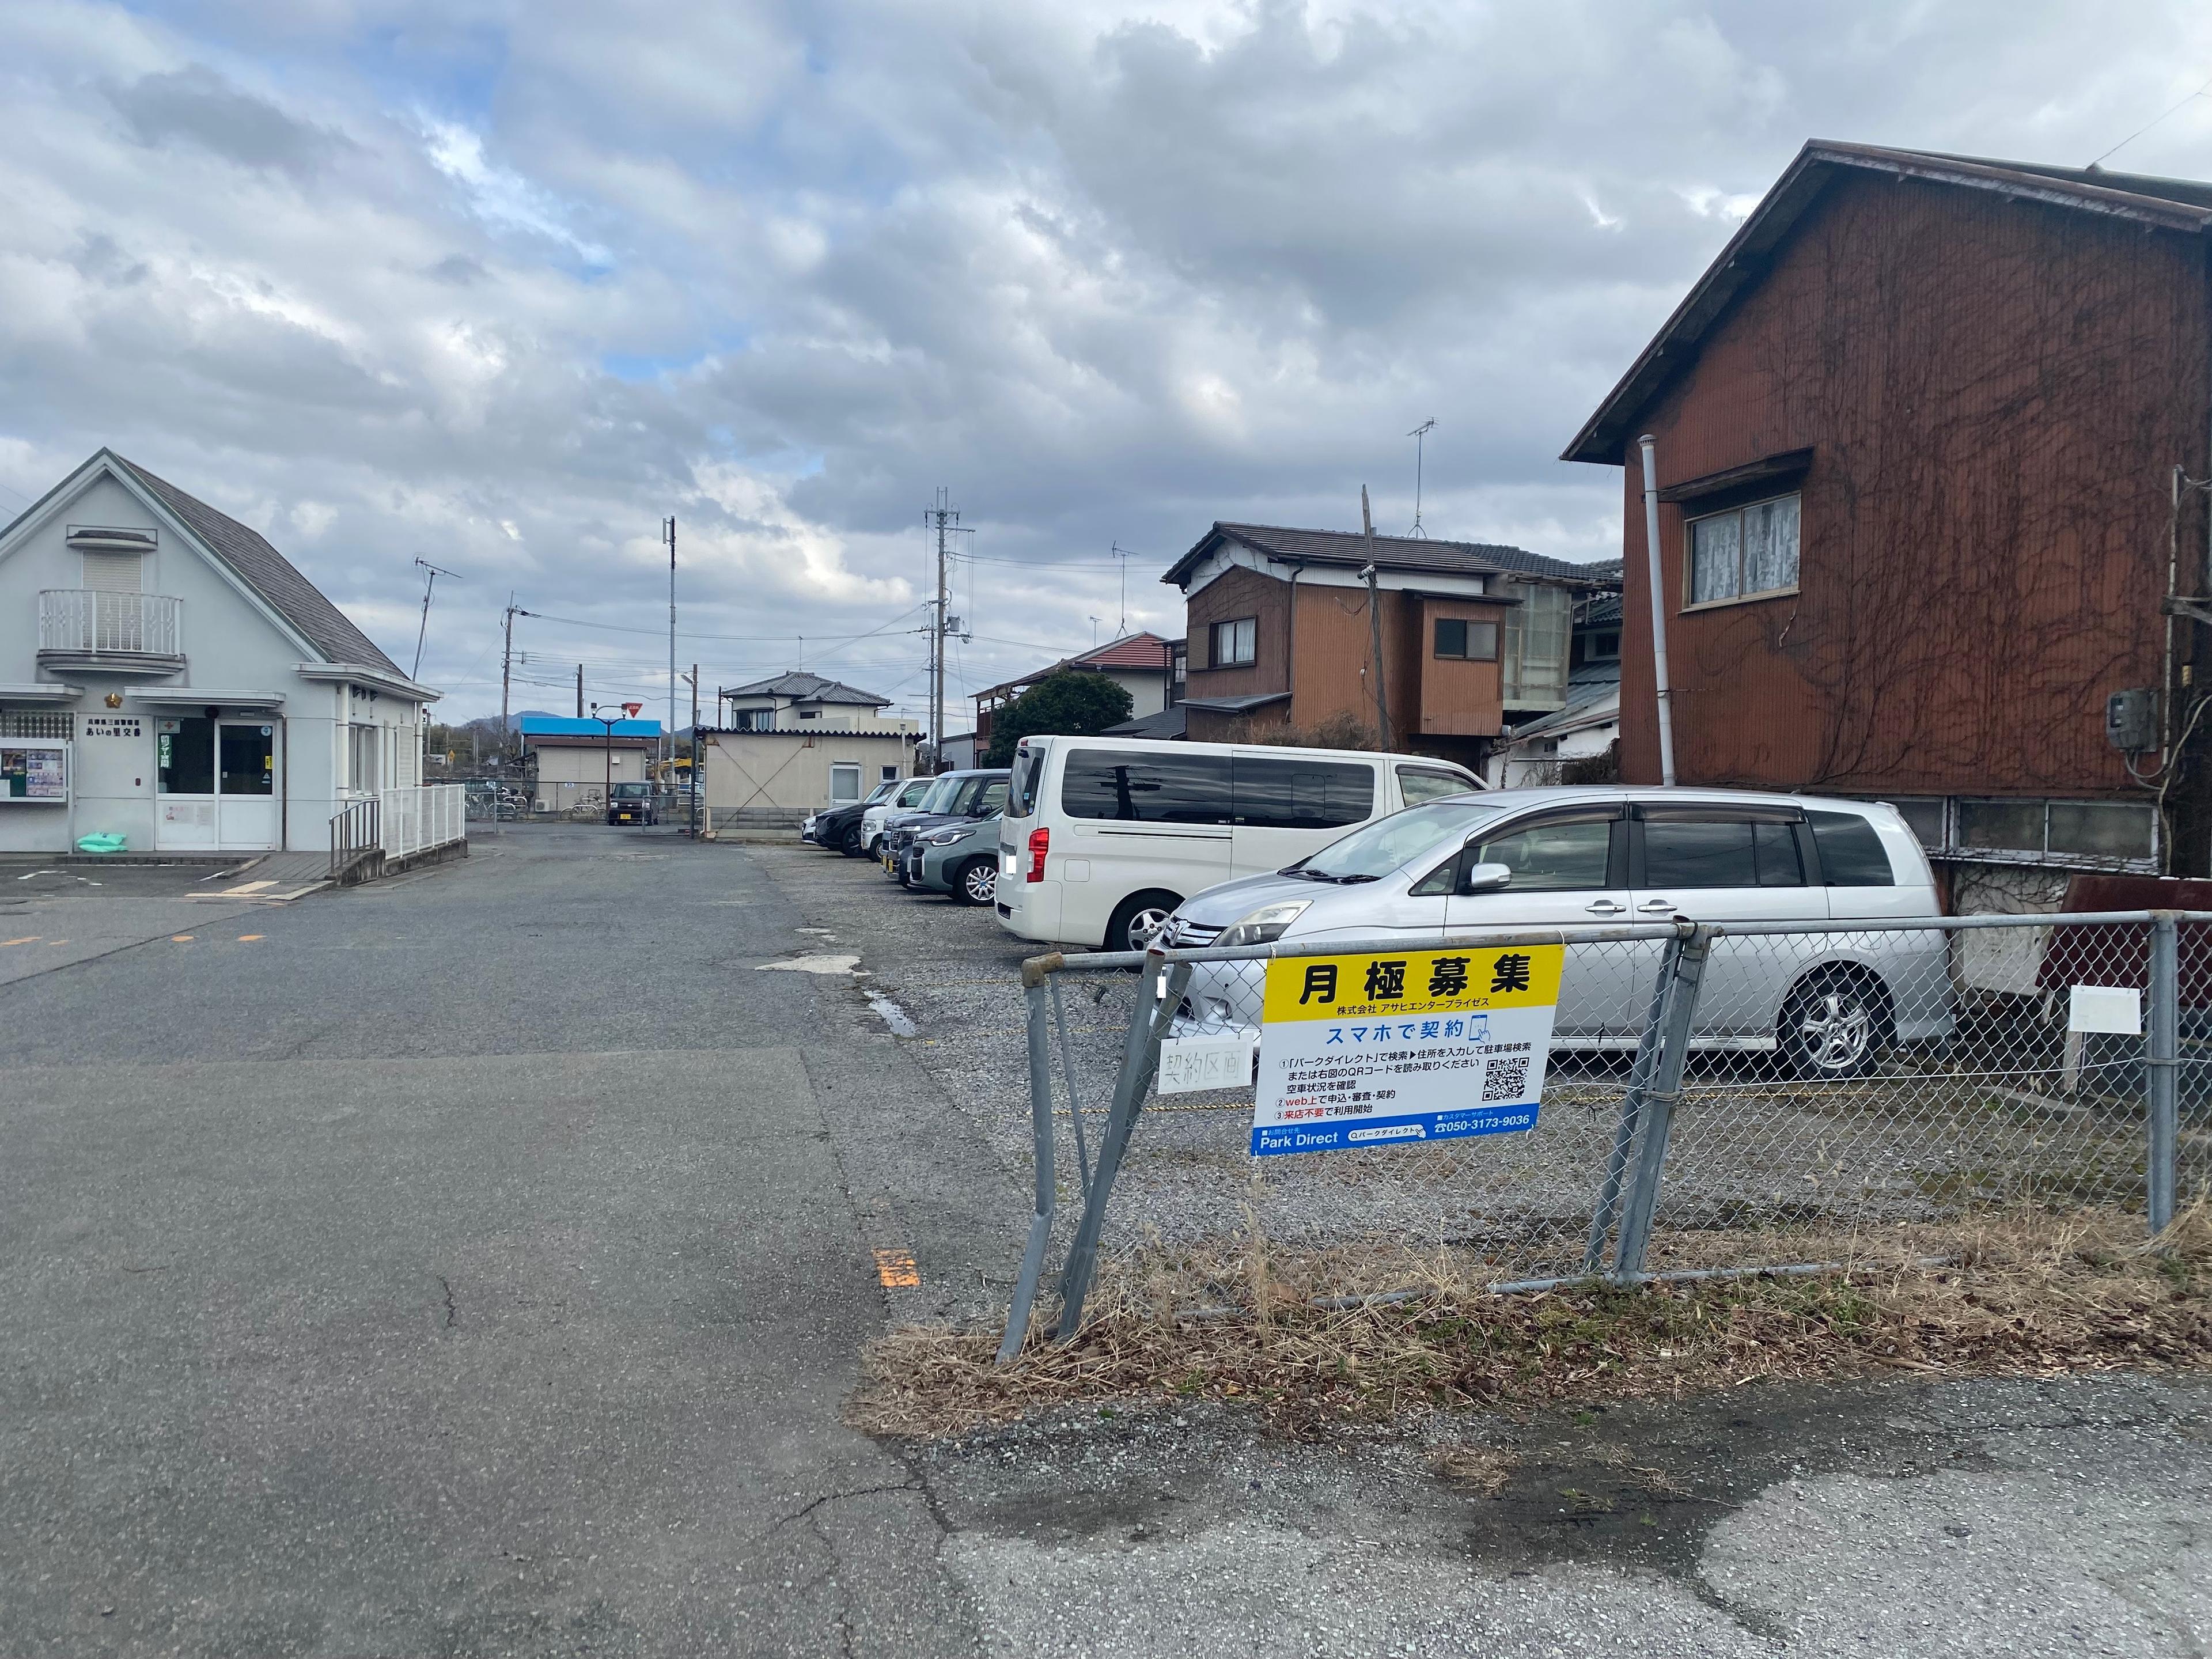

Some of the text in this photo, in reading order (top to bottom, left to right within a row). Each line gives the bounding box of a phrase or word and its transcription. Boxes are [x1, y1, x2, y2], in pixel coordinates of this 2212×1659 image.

[1299, 953, 1531, 1005] 月極募集
[1336, 997, 1489, 1016] 株式会社 アサヒエンタープライゼス
[1326, 1019, 1464, 1044] スマホで契約
[1164, 1050, 1241, 1086] 契約区画
[1288, 1058, 1479, 1081] または右図のQRコードを読み取りください
[1286, 1080, 1357, 1094] 空車状況を確認
[1260, 1131, 1339, 1149] Park Direct
